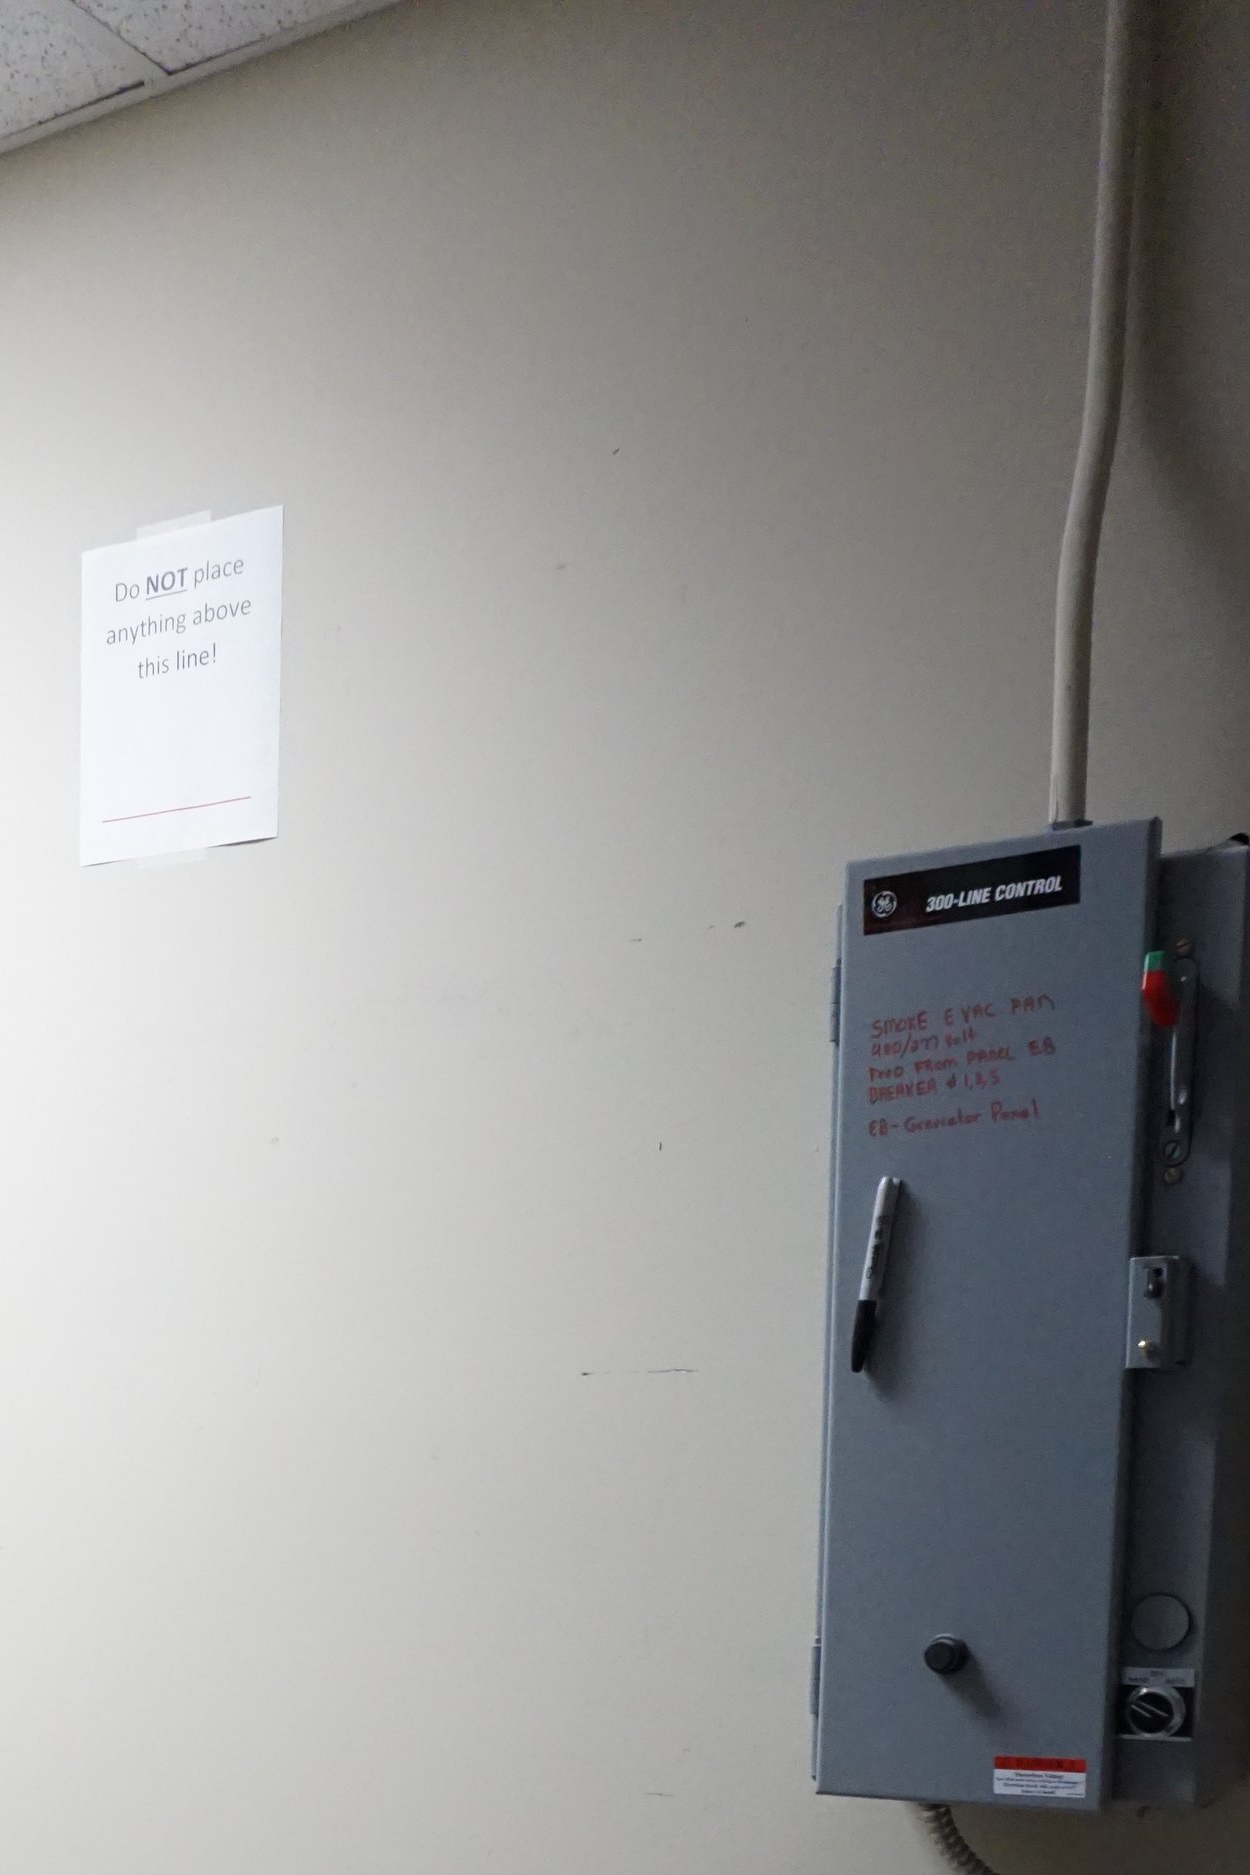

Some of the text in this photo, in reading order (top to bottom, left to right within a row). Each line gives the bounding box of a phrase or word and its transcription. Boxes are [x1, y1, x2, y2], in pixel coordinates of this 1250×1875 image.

[115, 559, 244, 603] Do NOT place
[106, 599, 252, 645] anything above
[138, 642, 216, 680] this line!
[925, 887, 991, 914] 300-LINE
[994, 874, 1063, 903] CONTROL
[870, 1009, 928, 1040] SMOKE
